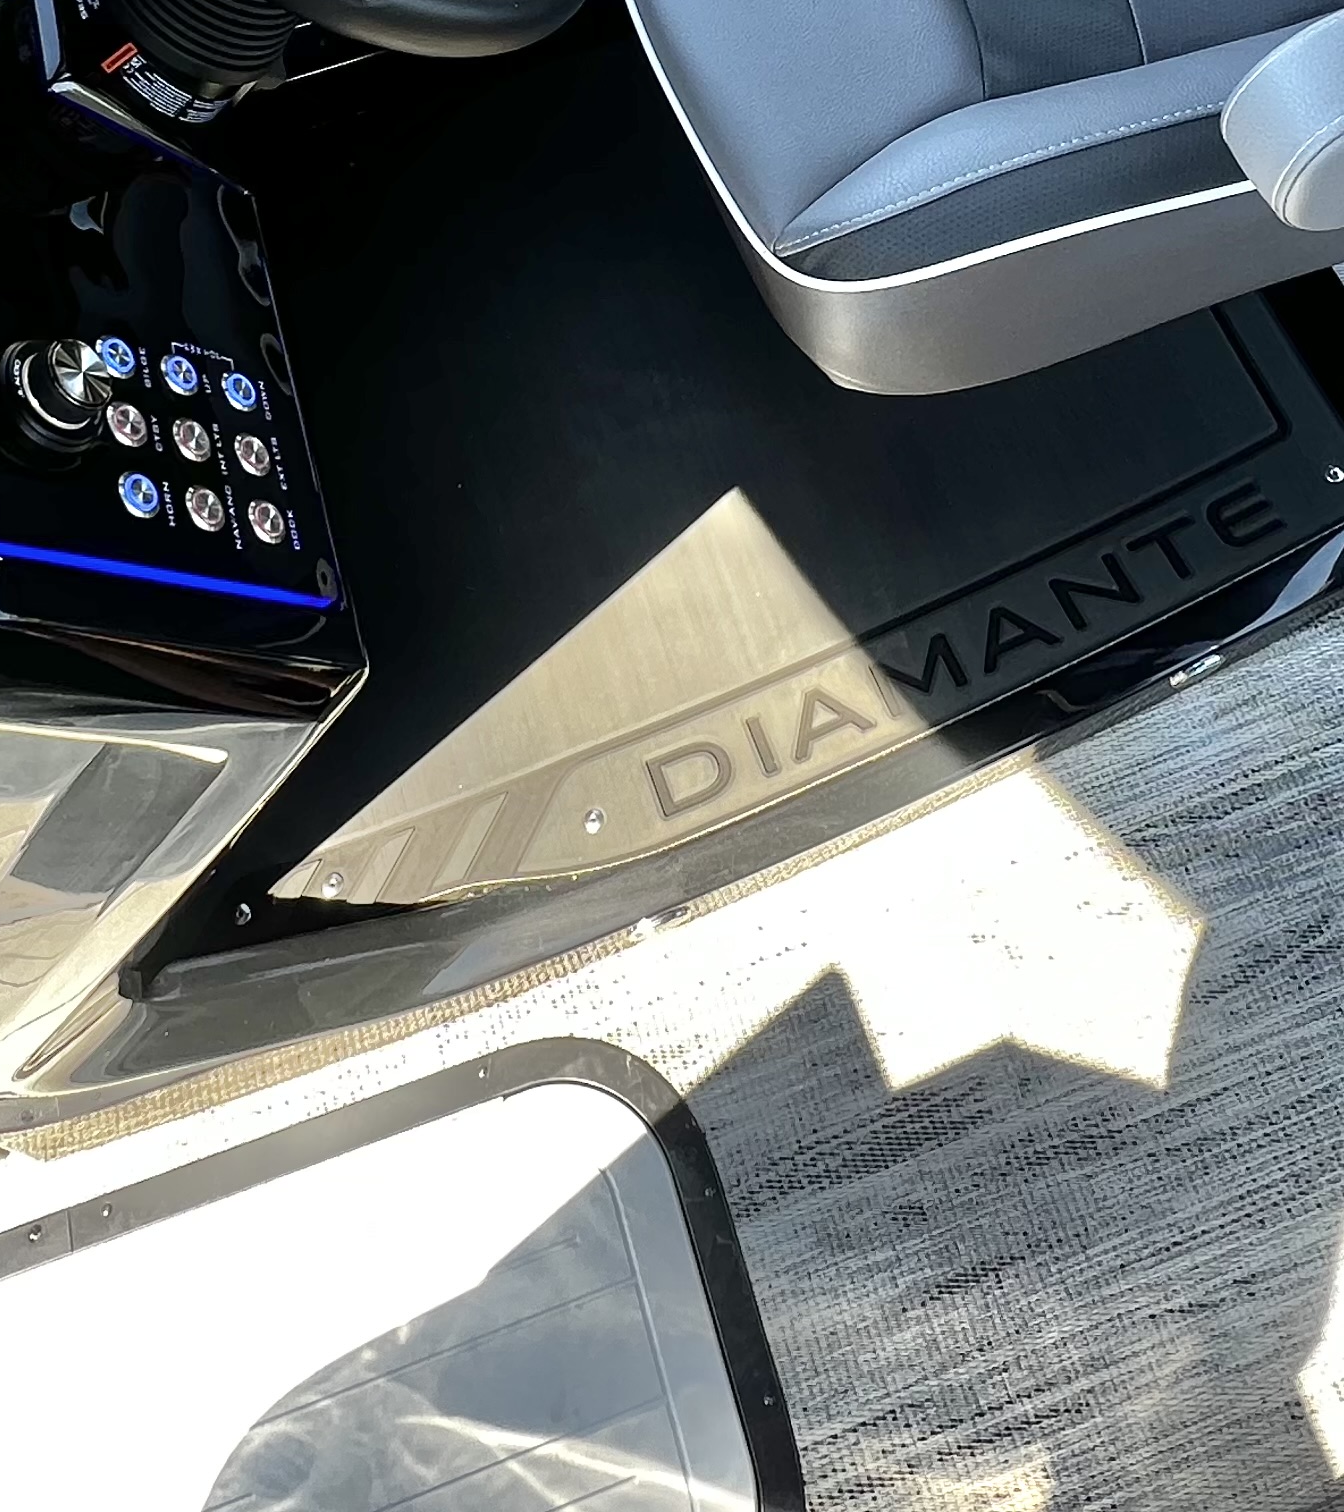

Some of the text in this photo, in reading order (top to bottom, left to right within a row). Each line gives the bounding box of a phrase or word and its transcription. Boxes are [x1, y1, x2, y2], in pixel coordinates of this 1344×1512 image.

[138, 346, 152, 388] BILGE
[201, 373, 211, 394] UP
[257, 380, 272, 421] DOWN
[217, 450, 229, 476] INT
[275, 463, 288, 491] EXT
[162, 481, 177, 527] HORN
[285, 509, 301, 551] DOCK
[644, 482, 1288, 820] DIAMANTE
